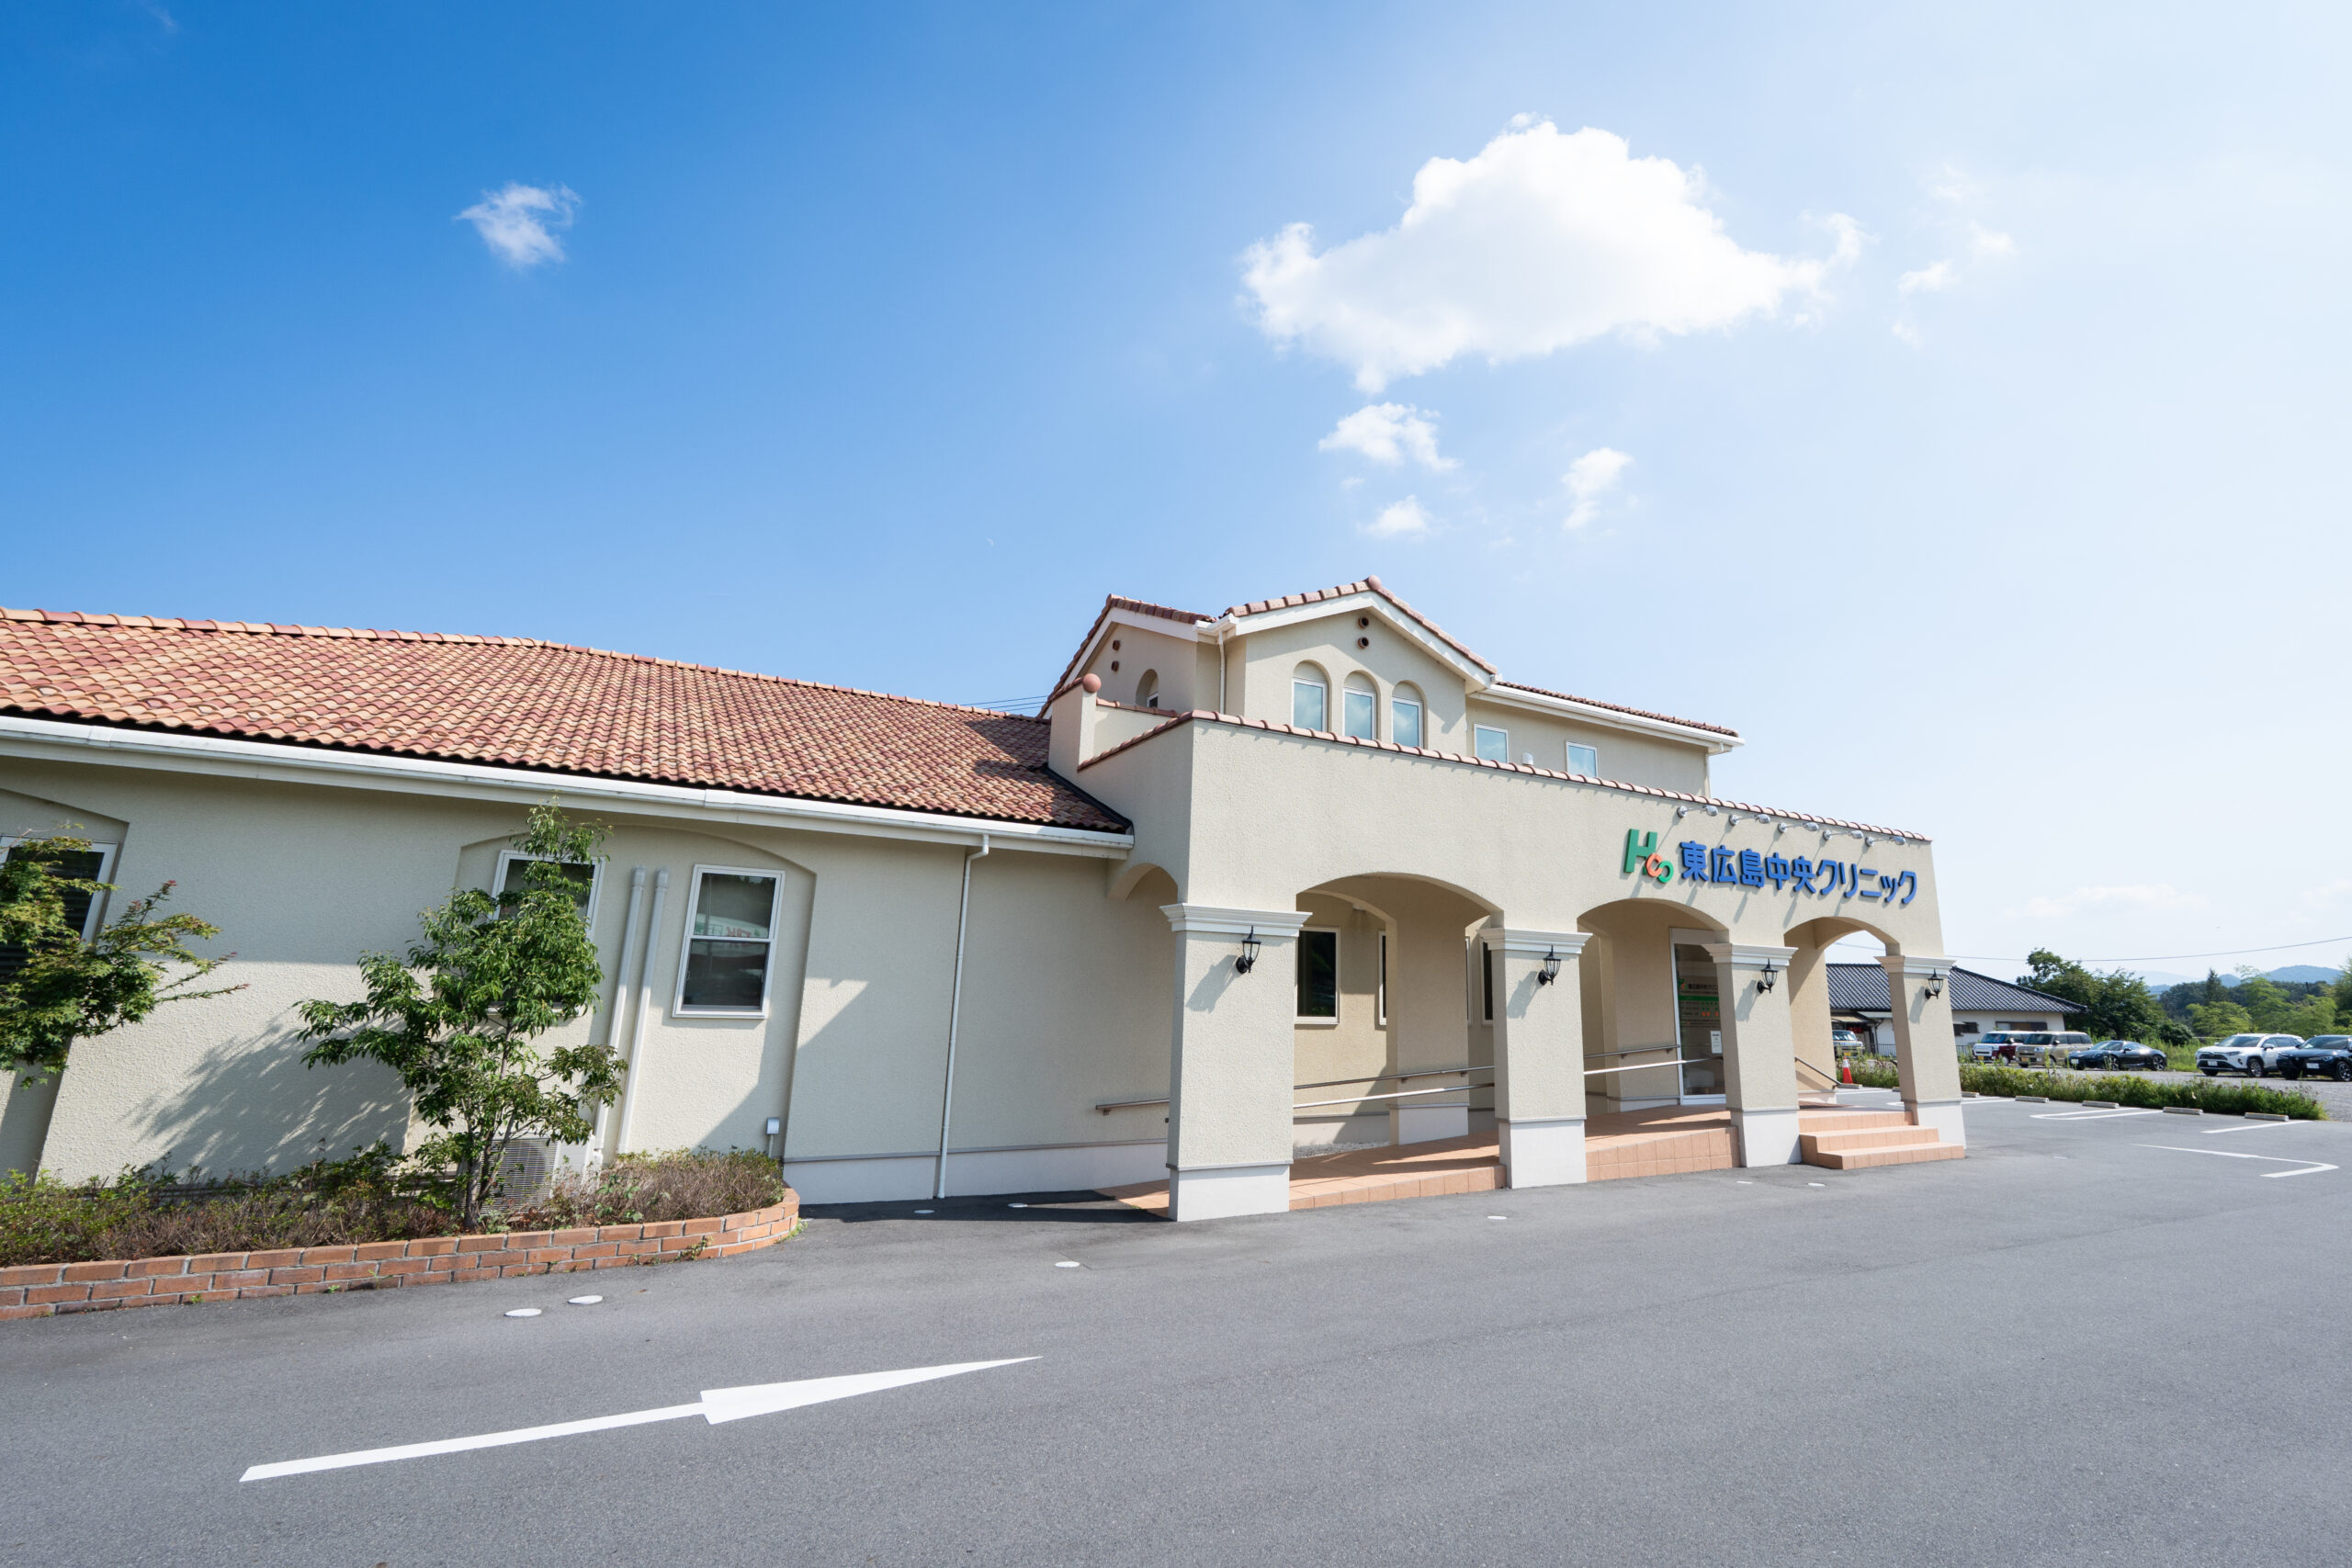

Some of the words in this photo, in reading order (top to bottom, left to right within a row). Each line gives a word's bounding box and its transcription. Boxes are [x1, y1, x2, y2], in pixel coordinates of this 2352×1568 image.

[1679, 840, 1917, 904] 東広島中央クリニック
